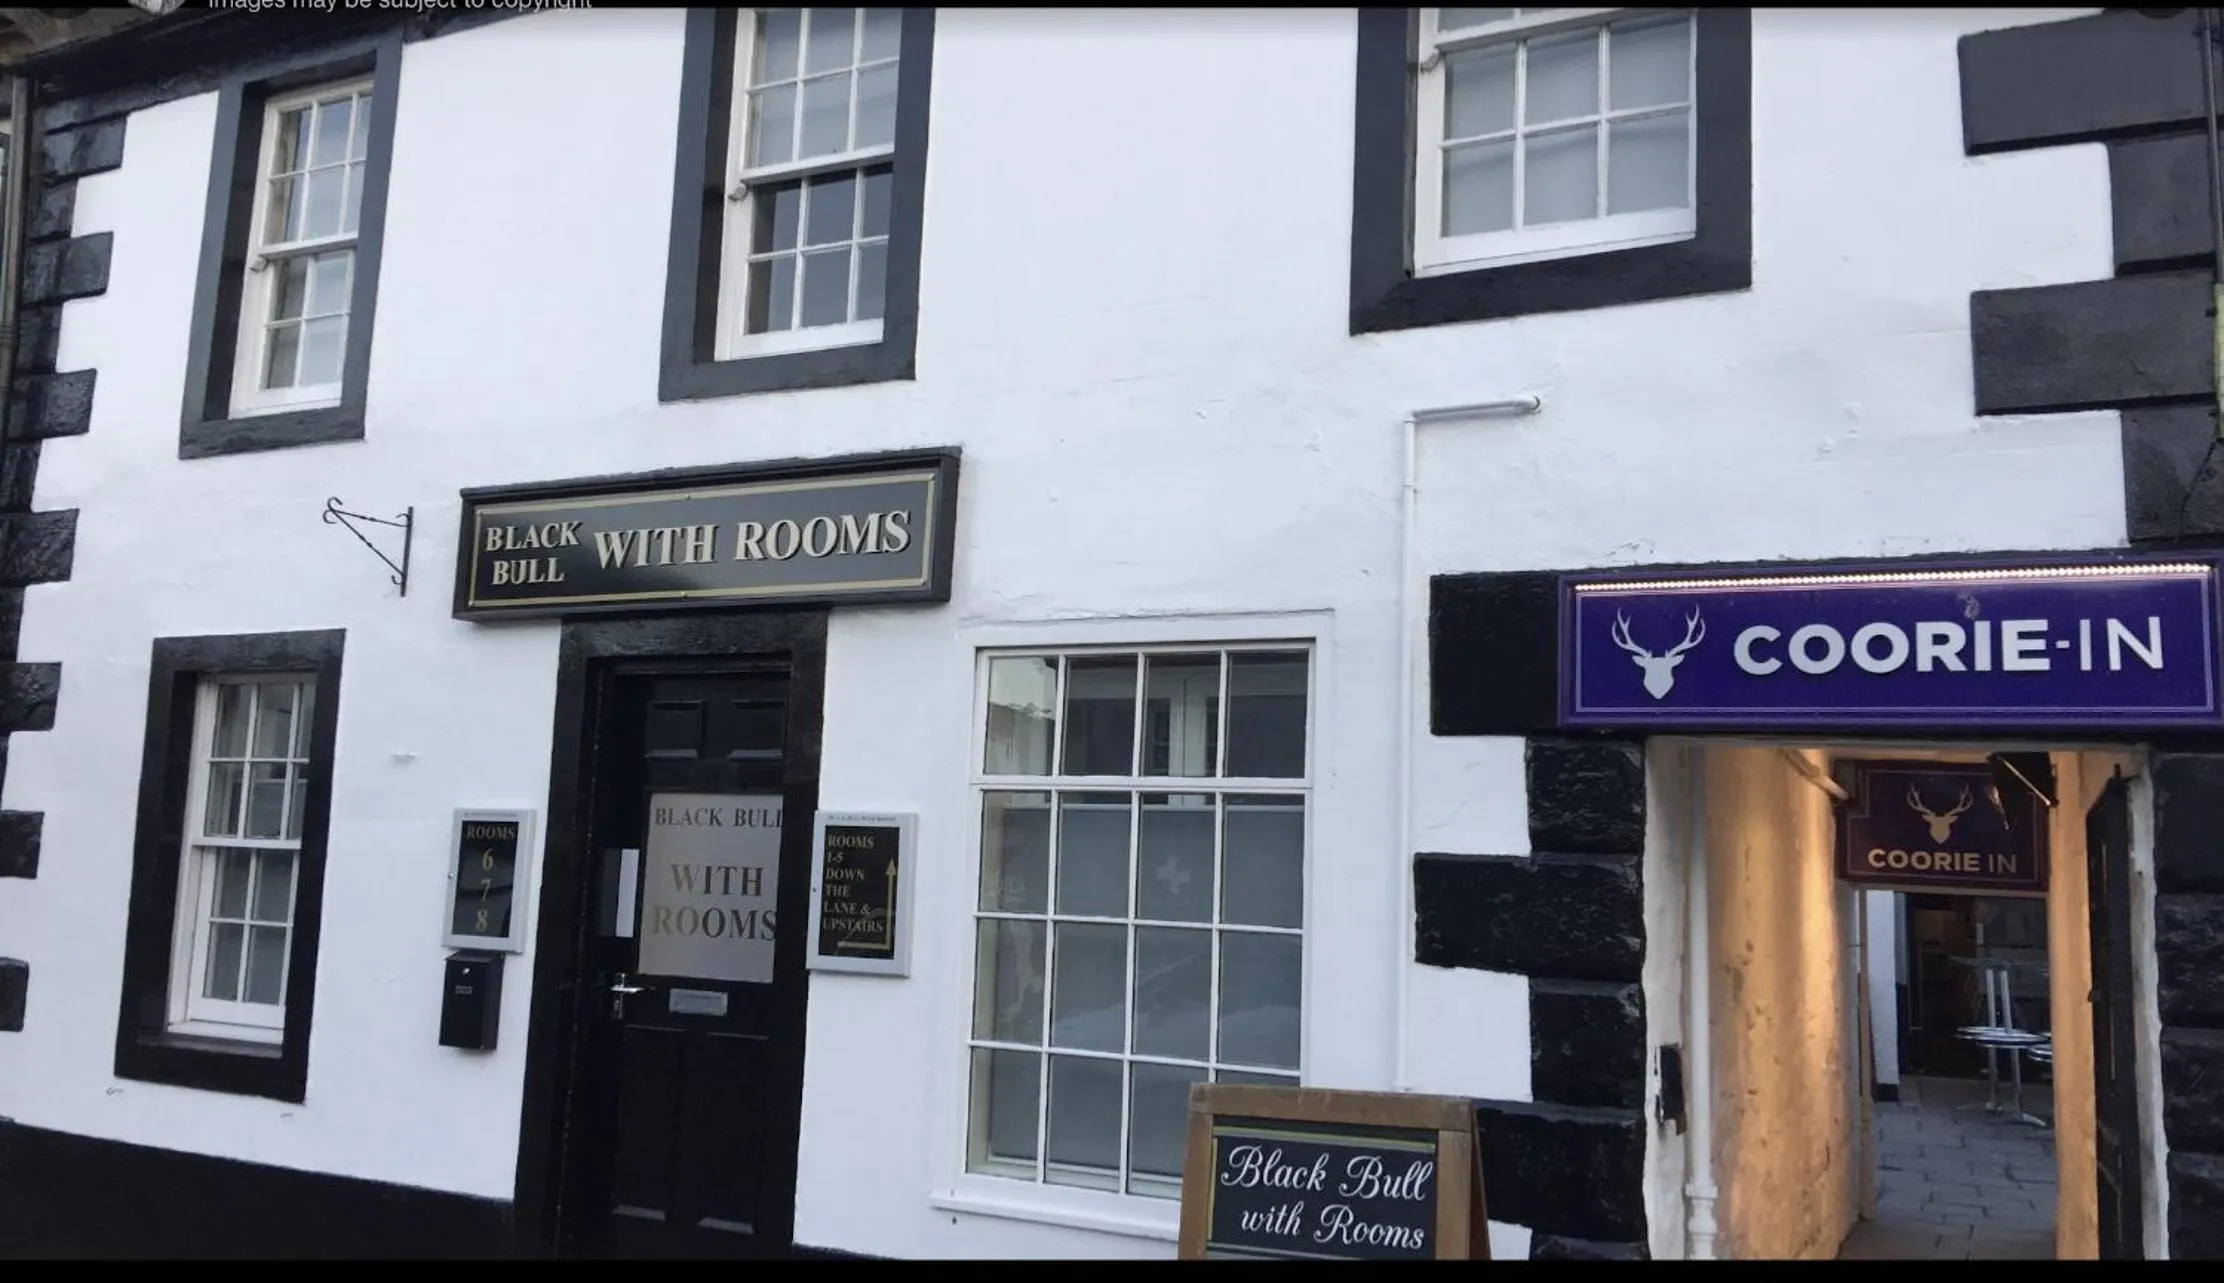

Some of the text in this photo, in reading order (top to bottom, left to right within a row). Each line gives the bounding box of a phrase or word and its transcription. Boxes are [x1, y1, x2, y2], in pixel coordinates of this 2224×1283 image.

[485, 521, 582, 552] BLACK
[594, 510, 912, 571] WITH ROOMS
[491, 558, 565, 586] BULL
[1733, 616, 2165, 676] COORIE-IN
[655, 807, 723, 827] BLACK
[467, 824, 516, 841] ROOMS
[828, 834, 875, 850] ROOMS
[482, 848, 494, 871] 6
[827, 851, 844, 864] 1-5
[1868, 848, 2017, 874] COORIE IN
[671, 863, 765, 897] WITH
[825, 867, 866, 881] DOWN
[481, 878, 492, 902] 7
[825, 883, 851, 898] THE
[823, 900, 872, 915] LANE &
[476, 909, 489, 932] 8
[651, 905, 777, 942] ROOMS
[822, 917, 884, 933] UPSTAIRS
[1221, 1144, 1435, 1201] Black Bull
[1241, 1200, 1425, 1250] with Rooms
